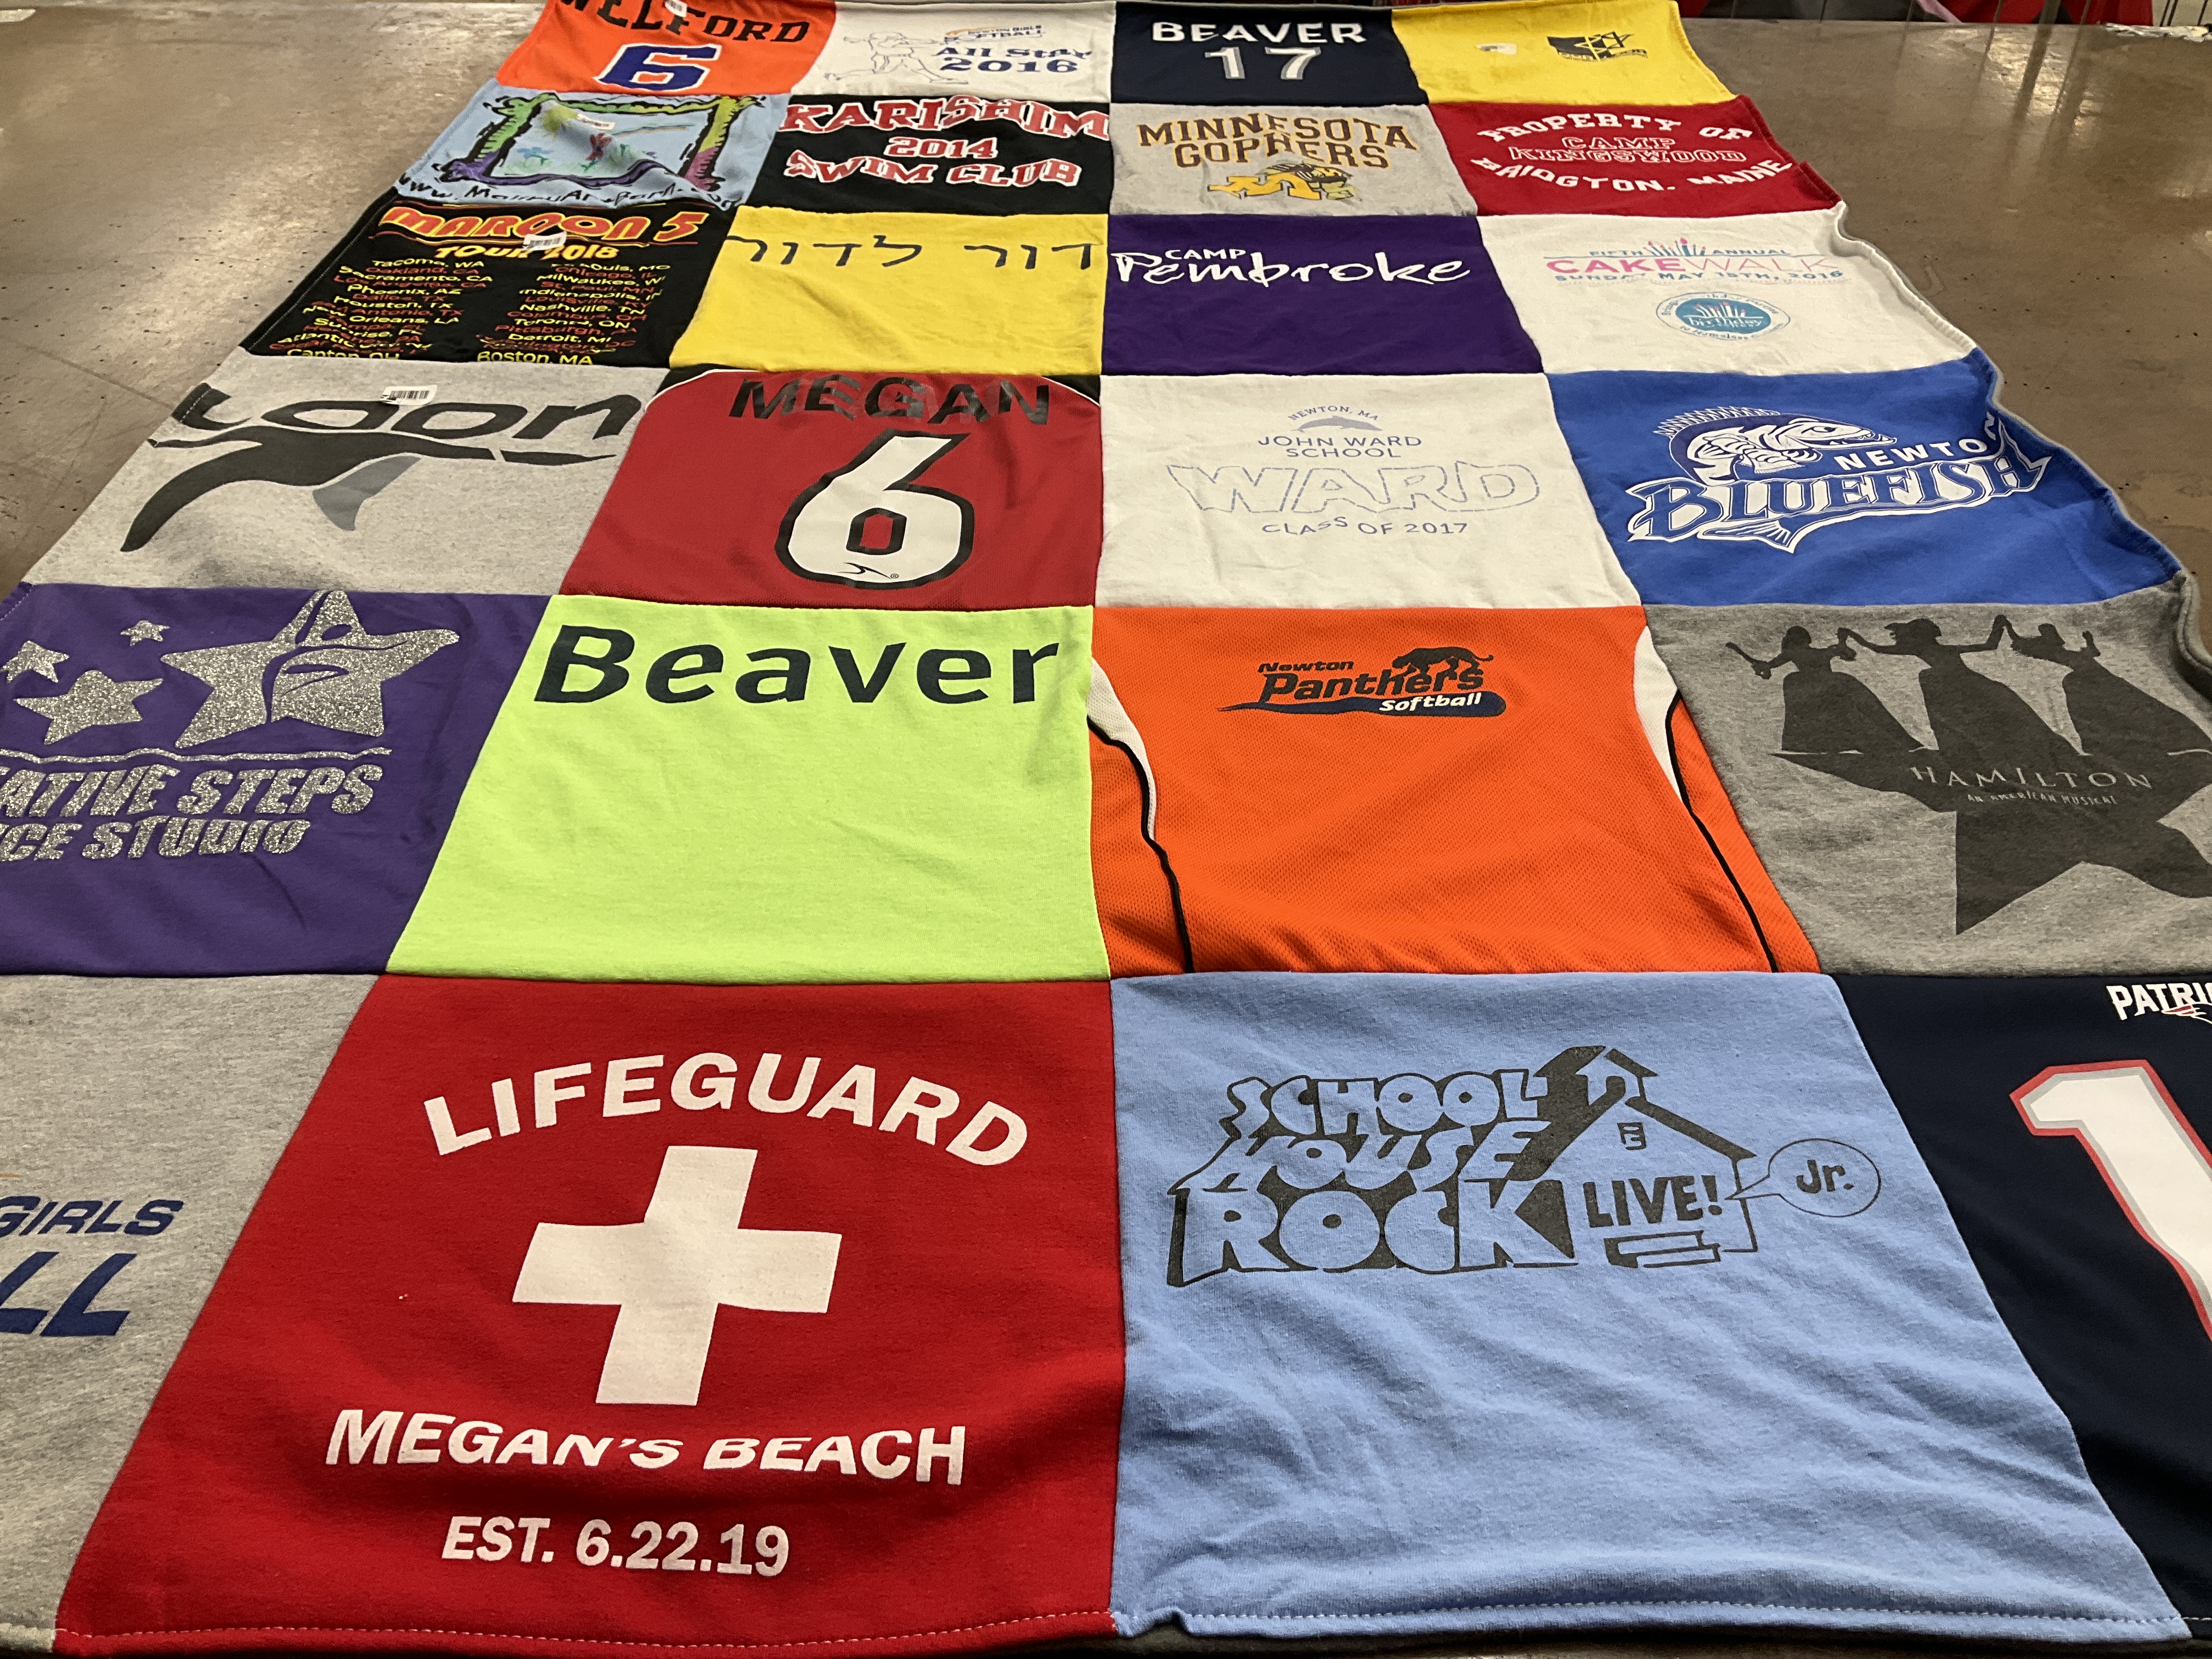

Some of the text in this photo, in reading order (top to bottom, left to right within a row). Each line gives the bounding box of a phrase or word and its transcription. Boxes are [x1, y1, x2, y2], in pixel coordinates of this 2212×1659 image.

[560, 0, 810, 43] ELFORD
[1153, 21, 1366, 43] BEAVER
[594, 43, 721, 92] 6
[933, 47, 1092, 59] All Star
[940, 57, 1078, 72] 2016
[1205, 46, 1321, 80] 17
[779, 95, 1110, 140] KARISHIM
[1136, 113, 1419, 151] MINNESOTA
[1477, 113, 1753, 142] PROPERTY OF
[884, 137, 997, 159] 2014
[1174, 131, 1391, 169] GOPHERS
[1509, 146, 1747, 163] KINGSWOOD
[1561, 136, 1675, 149] CAMP
[784, 150, 1082, 187] SWIM CLUB
[1686, 160, 1793, 184] MAINE
[653, 211, 710, 242] 5
[371, 258, 449, 268] Tacoma,
[539, 244, 620, 261] 2018
[726, 235, 1092, 270] דור לדור
[1165, 249, 1246, 260] CAMP
[338, 266, 461, 281] Sacramento,
[536, 273, 640, 286] Milwaukee,
[1111, 251, 1471, 288] Pembroke
[1658, 272, 1703, 280] MAY
[347, 284, 430, 295] Phoenix,
[349, 316, 429, 324] Orleans,
[519, 303, 646, 315] Nashville, TN
[507, 333, 582, 343] Detroit,
[598, 320, 631, 329] ON
[560, 354, 594, 365] MA
[729, 374, 1049, 425] MEGAN
[1288, 405, 1379, 421] NEWTON, MA
[1258, 436, 1422, 447] JOHN WARD
[1286, 448, 1402, 458] SCHOOL
[1166, 459, 1540, 514] WARD
[1629, 455, 2042, 542] BLUEFISH
[774, 428, 975, 590] 6
[1261, 516, 1468, 535] CLASS OF 2017
[534, 624, 1059, 704] Beaver
[1257, 660, 1354, 673] Newton
[1258, 668, 1483, 703] Panthers
[1379, 691, 1482, 712] Softball
[0, 764, 383, 817] ATIVE STEPS
[1910, 766, 2154, 789] HAMILTON
[0, 815, 311, 863] CE STUDIO
[423, 1052, 1029, 1166] LIFEGUARD
[1219, 1070, 1548, 1137] SCHOOL
[1174, 1119, 1551, 1192] HOUSE
[1795, 1158, 1855, 1194] Jr.
[0, 1195, 185, 1238] GIRLS
[1583, 1175, 1723, 1228] LIVE!
[1167, 1180, 1578, 1284] ROCK
[326, 1409, 967, 1486] MEGAN'S BEACH
[441, 1516, 790, 1578] EST. 6.22.19
